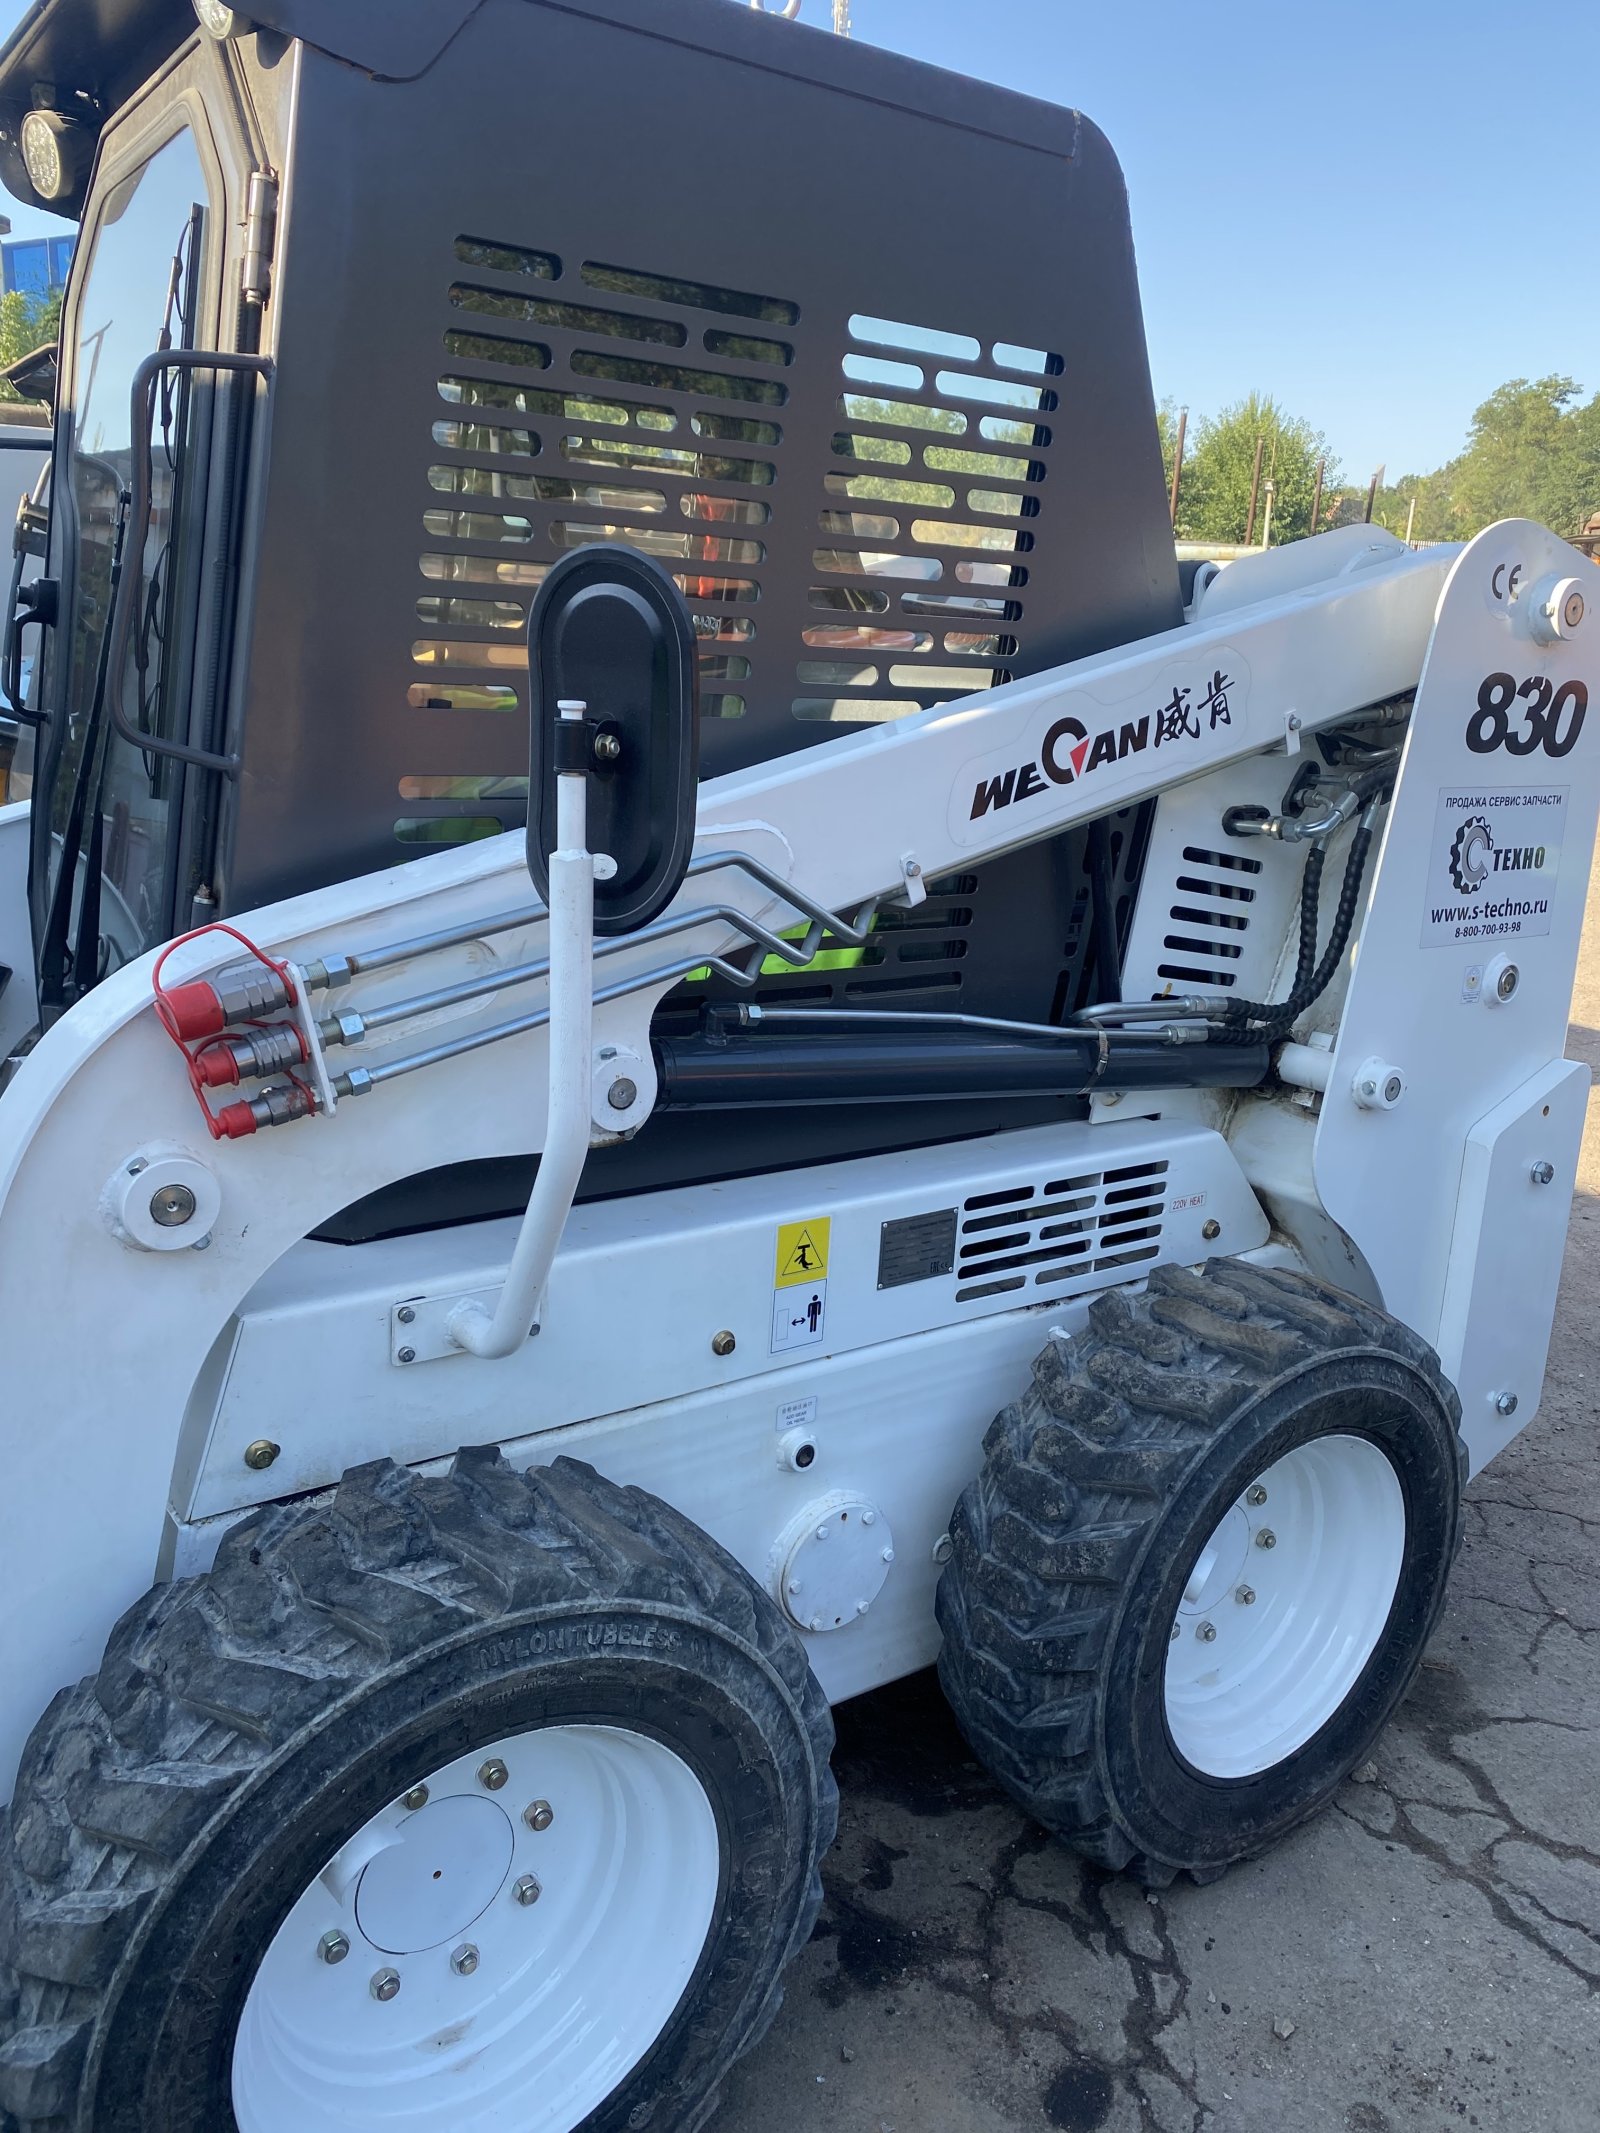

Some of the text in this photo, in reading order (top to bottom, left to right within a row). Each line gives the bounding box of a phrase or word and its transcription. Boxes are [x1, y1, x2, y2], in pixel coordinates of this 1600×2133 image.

[1492, 564, 1522, 600] CE
[1154, 670, 1235, 748] 威肯
[1466, 672, 1588, 758] 830
[970, 715, 1149, 820] WECAN
[1446, 795, 1562, 809] ПРОДАЖА СЕРВИС ЗАПЧАСТИ
[1493, 847, 1545, 871] ТЕХНО
[1431, 898, 1548, 923] www.s-techno.ru
[1455, 921, 1521, 938] 8-800-700-93-98
[1173, 1195, 1204, 1210] 220V HEAT
[479, 1628, 565, 1669] NYLON
[572, 1623, 681, 1652] TUBELESS
